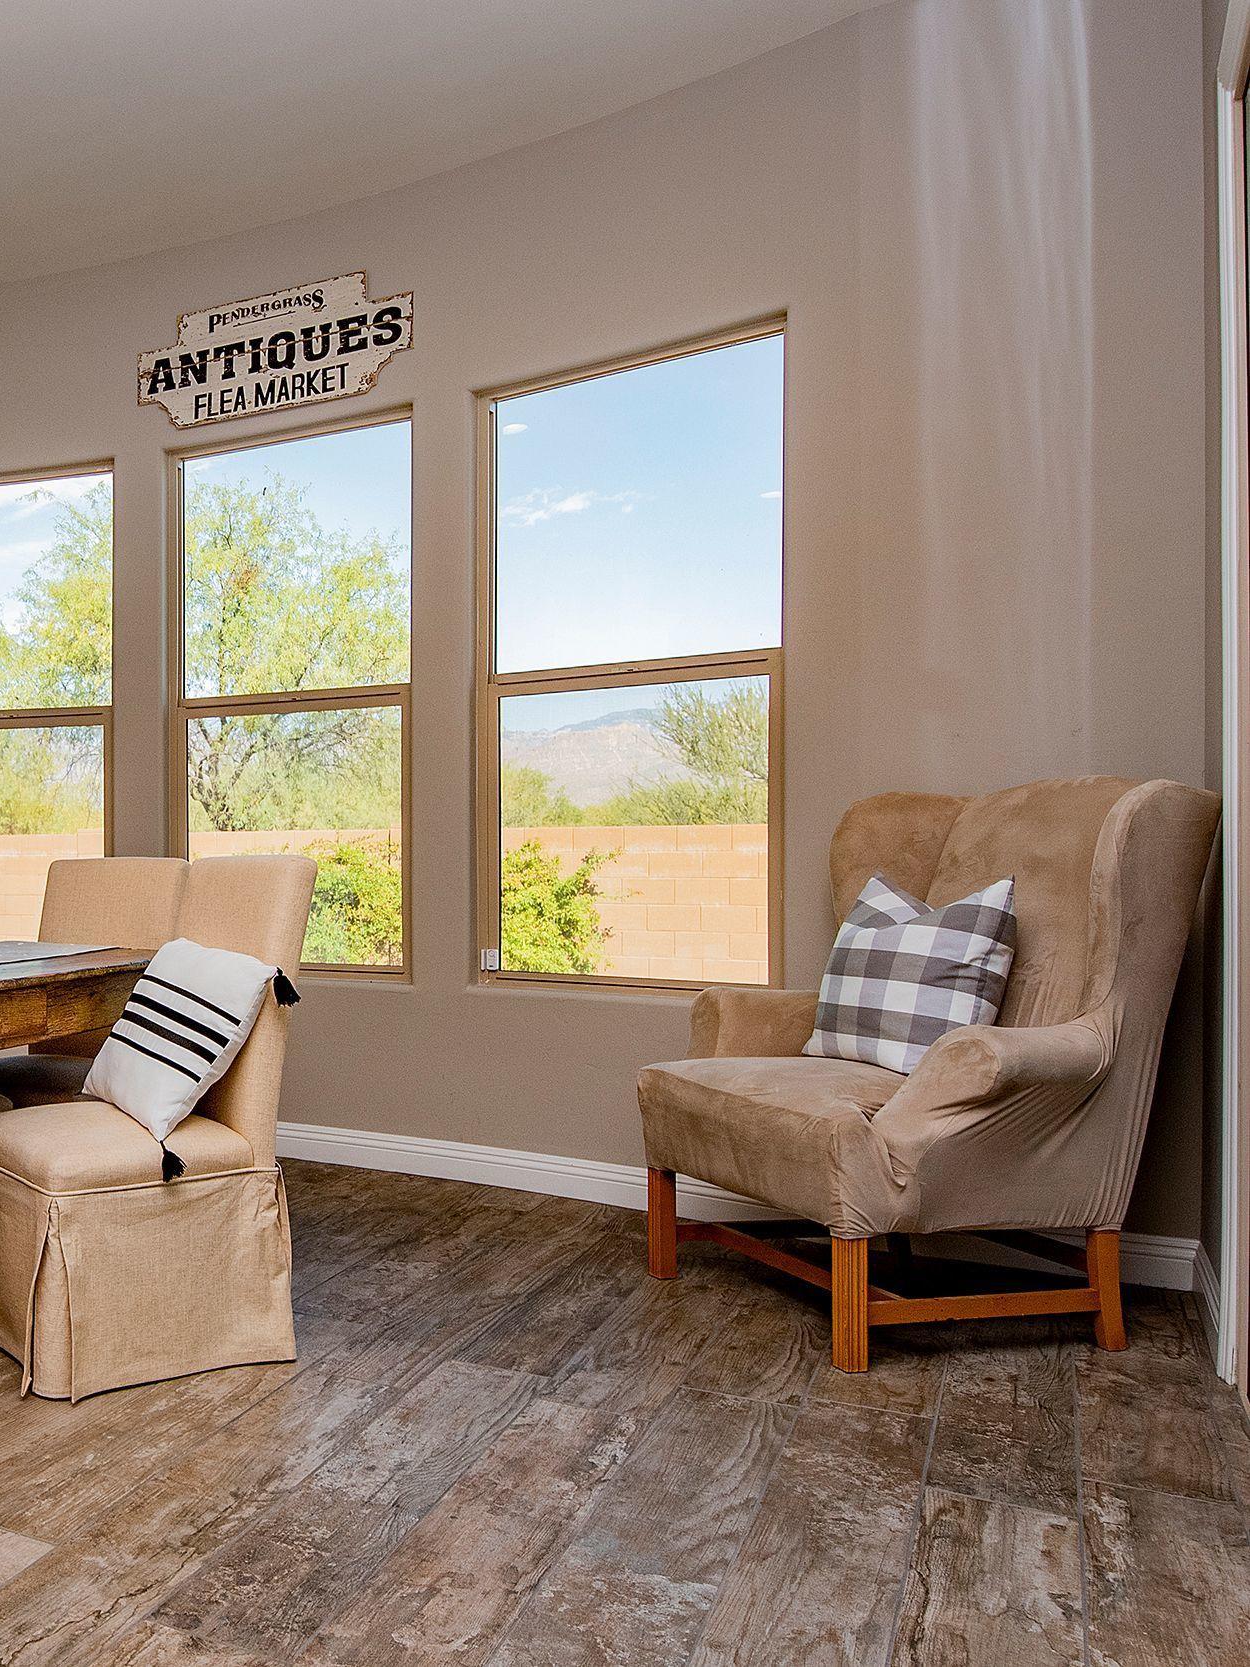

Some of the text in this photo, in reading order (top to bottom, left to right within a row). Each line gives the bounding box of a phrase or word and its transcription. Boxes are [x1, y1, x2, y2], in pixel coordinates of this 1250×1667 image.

[208, 288, 327, 333] PENDERGRASS
[147, 306, 402, 395] ANTIQUES
[194, 363, 349, 419] FLEA MARKET
